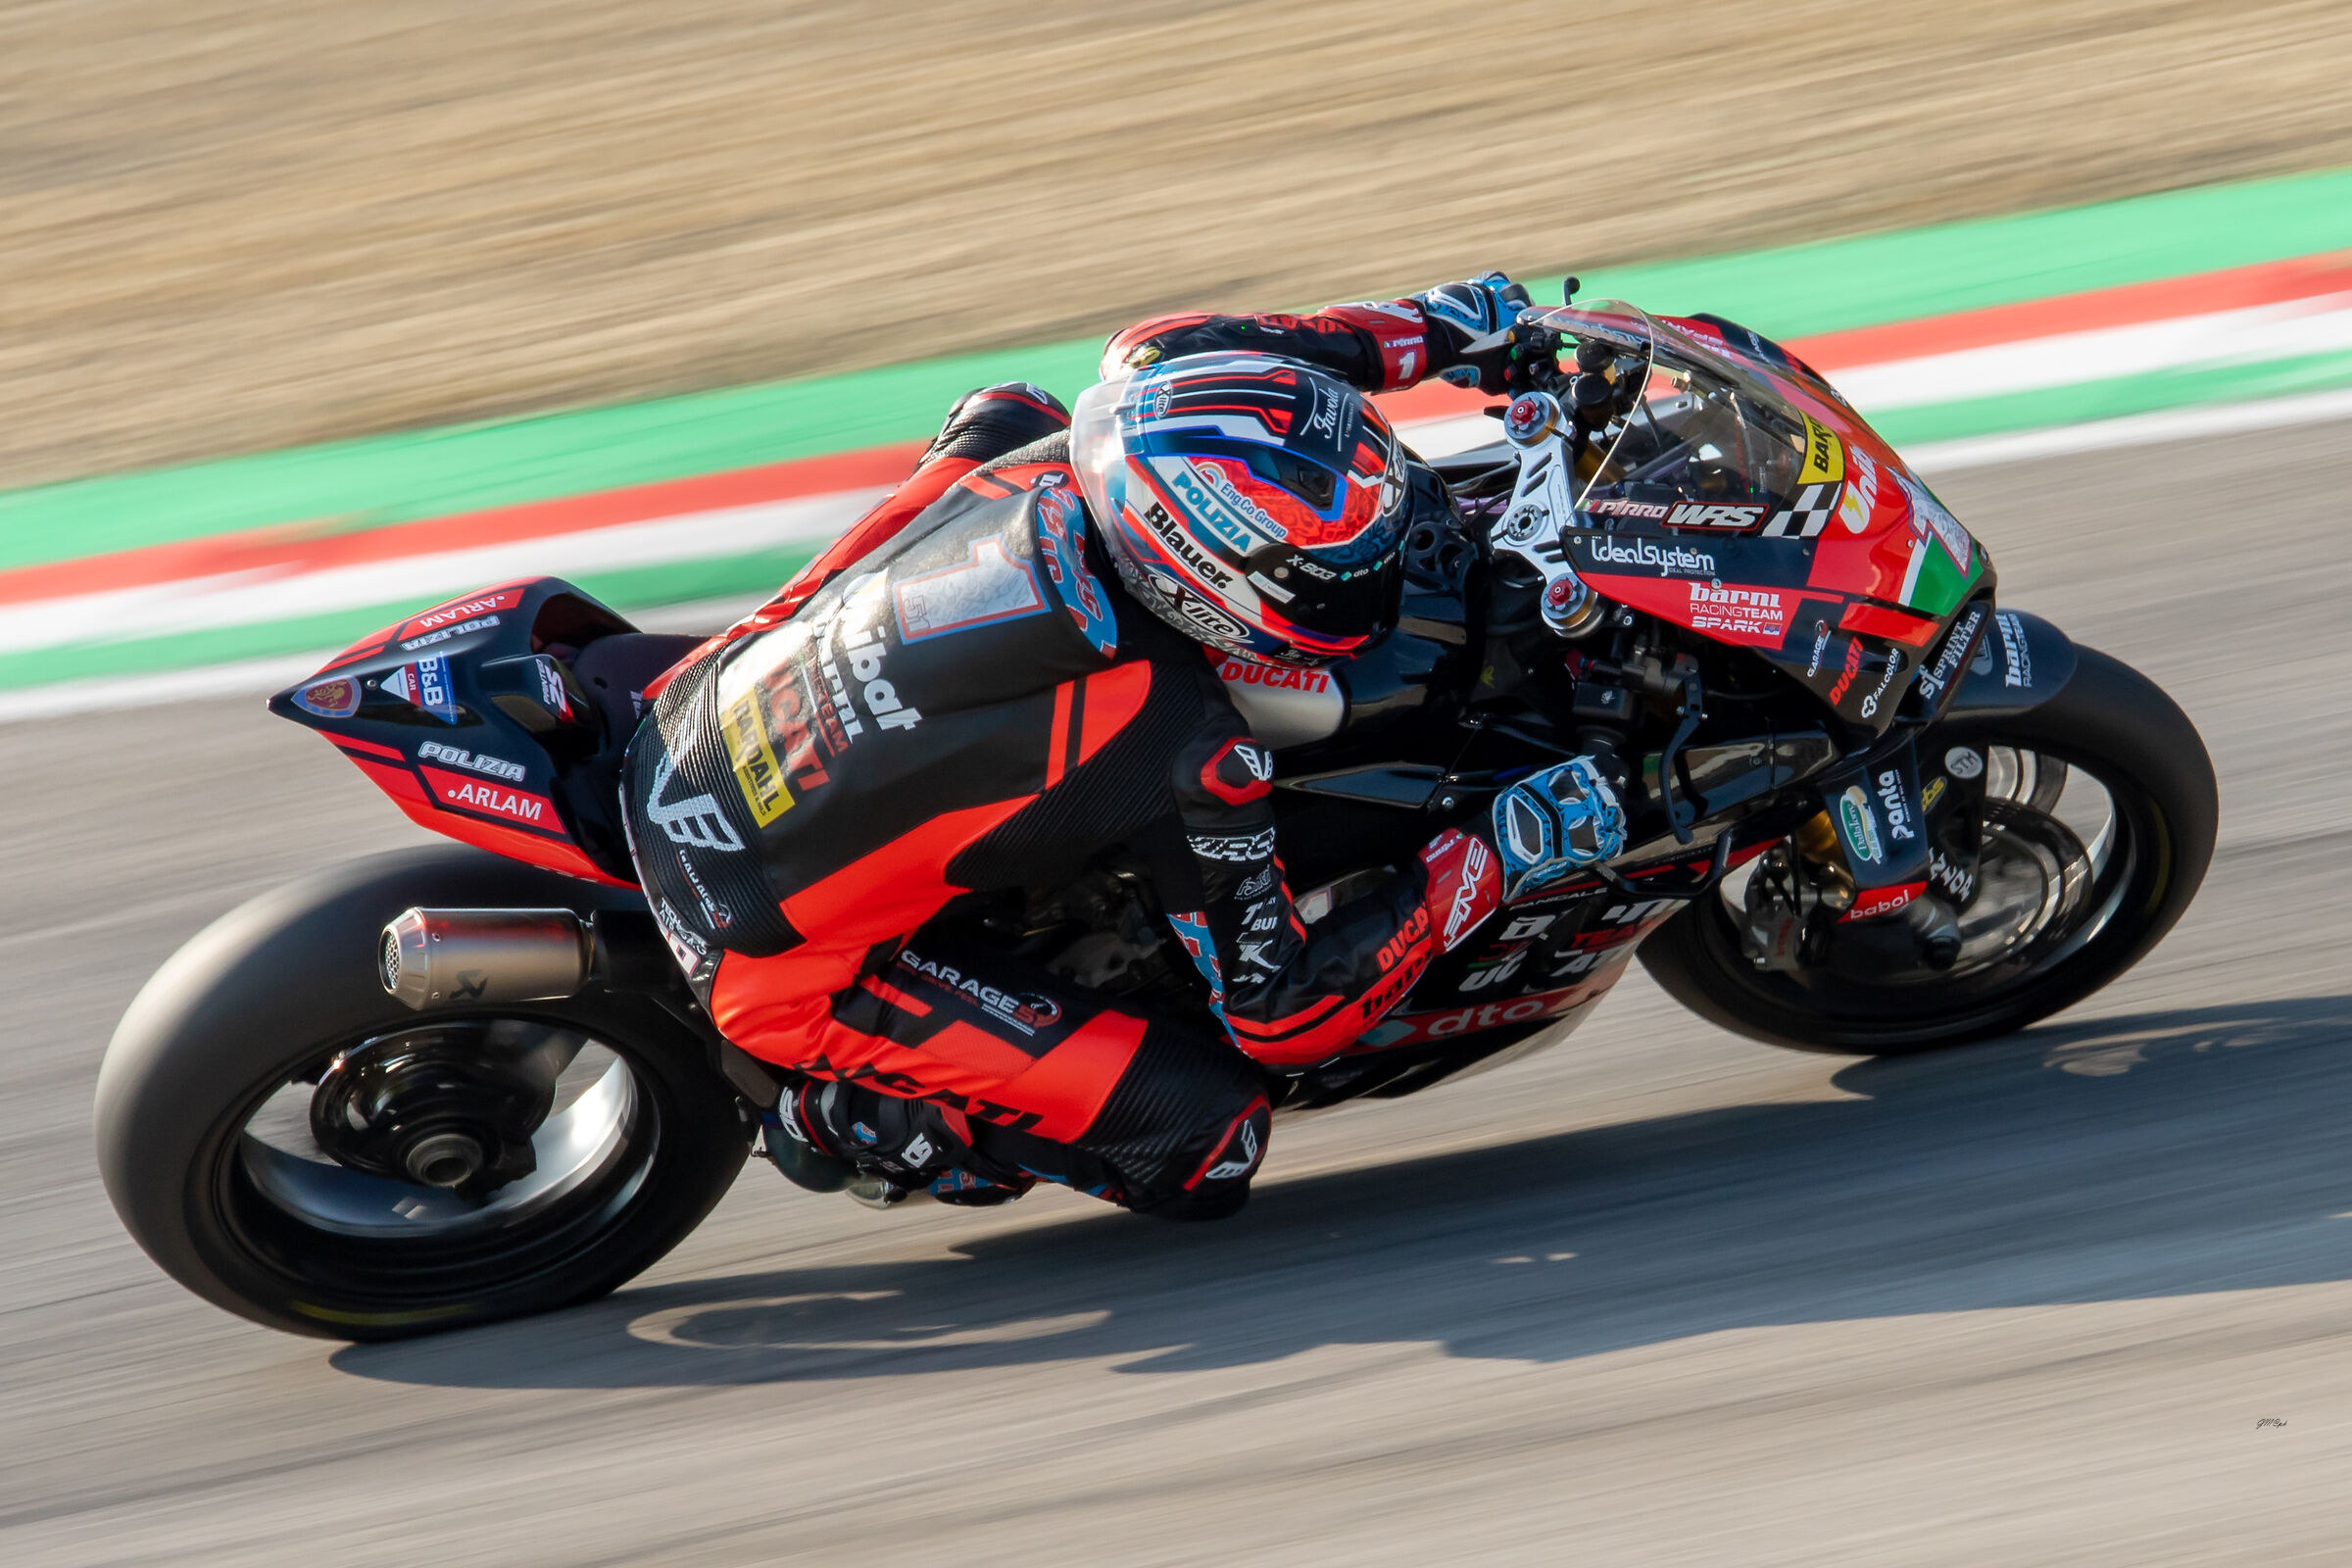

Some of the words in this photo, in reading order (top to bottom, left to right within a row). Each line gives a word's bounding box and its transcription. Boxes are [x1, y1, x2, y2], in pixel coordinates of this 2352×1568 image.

[1397, 351, 1416, 380] 1
[1171, 470, 1251, 552] POLIZIA
[1666, 504, 1764, 527] WRS
[1286, 554, 1337, 580] X-803
[1689, 582, 1781, 608] barni
[1690, 603, 1783, 621] RACINGTEAM
[401, 614, 501, 651] POLIZIA
[1691, 615, 1763, 634] SPARK
[1948, 612, 1981, 668] FILTER
[1934, 621, 1964, 678] SPRINT
[407, 672, 416, 691] CAR
[417, 657, 444, 707] B&B
[1221, 662, 1329, 694] DUCATI
[1829, 637, 1863, 706] DUCATI
[1873, 648, 1899, 701] FALCOLOR
[417, 740, 526, 782] POLIZIA
[733, 700, 781, 813] BARDAHL
[1950, 752, 1979, 774] STM
[1878, 770, 1915, 840] panta
[1850, 890, 1909, 919] babol
[1427, 1000, 1544, 1036] dto
